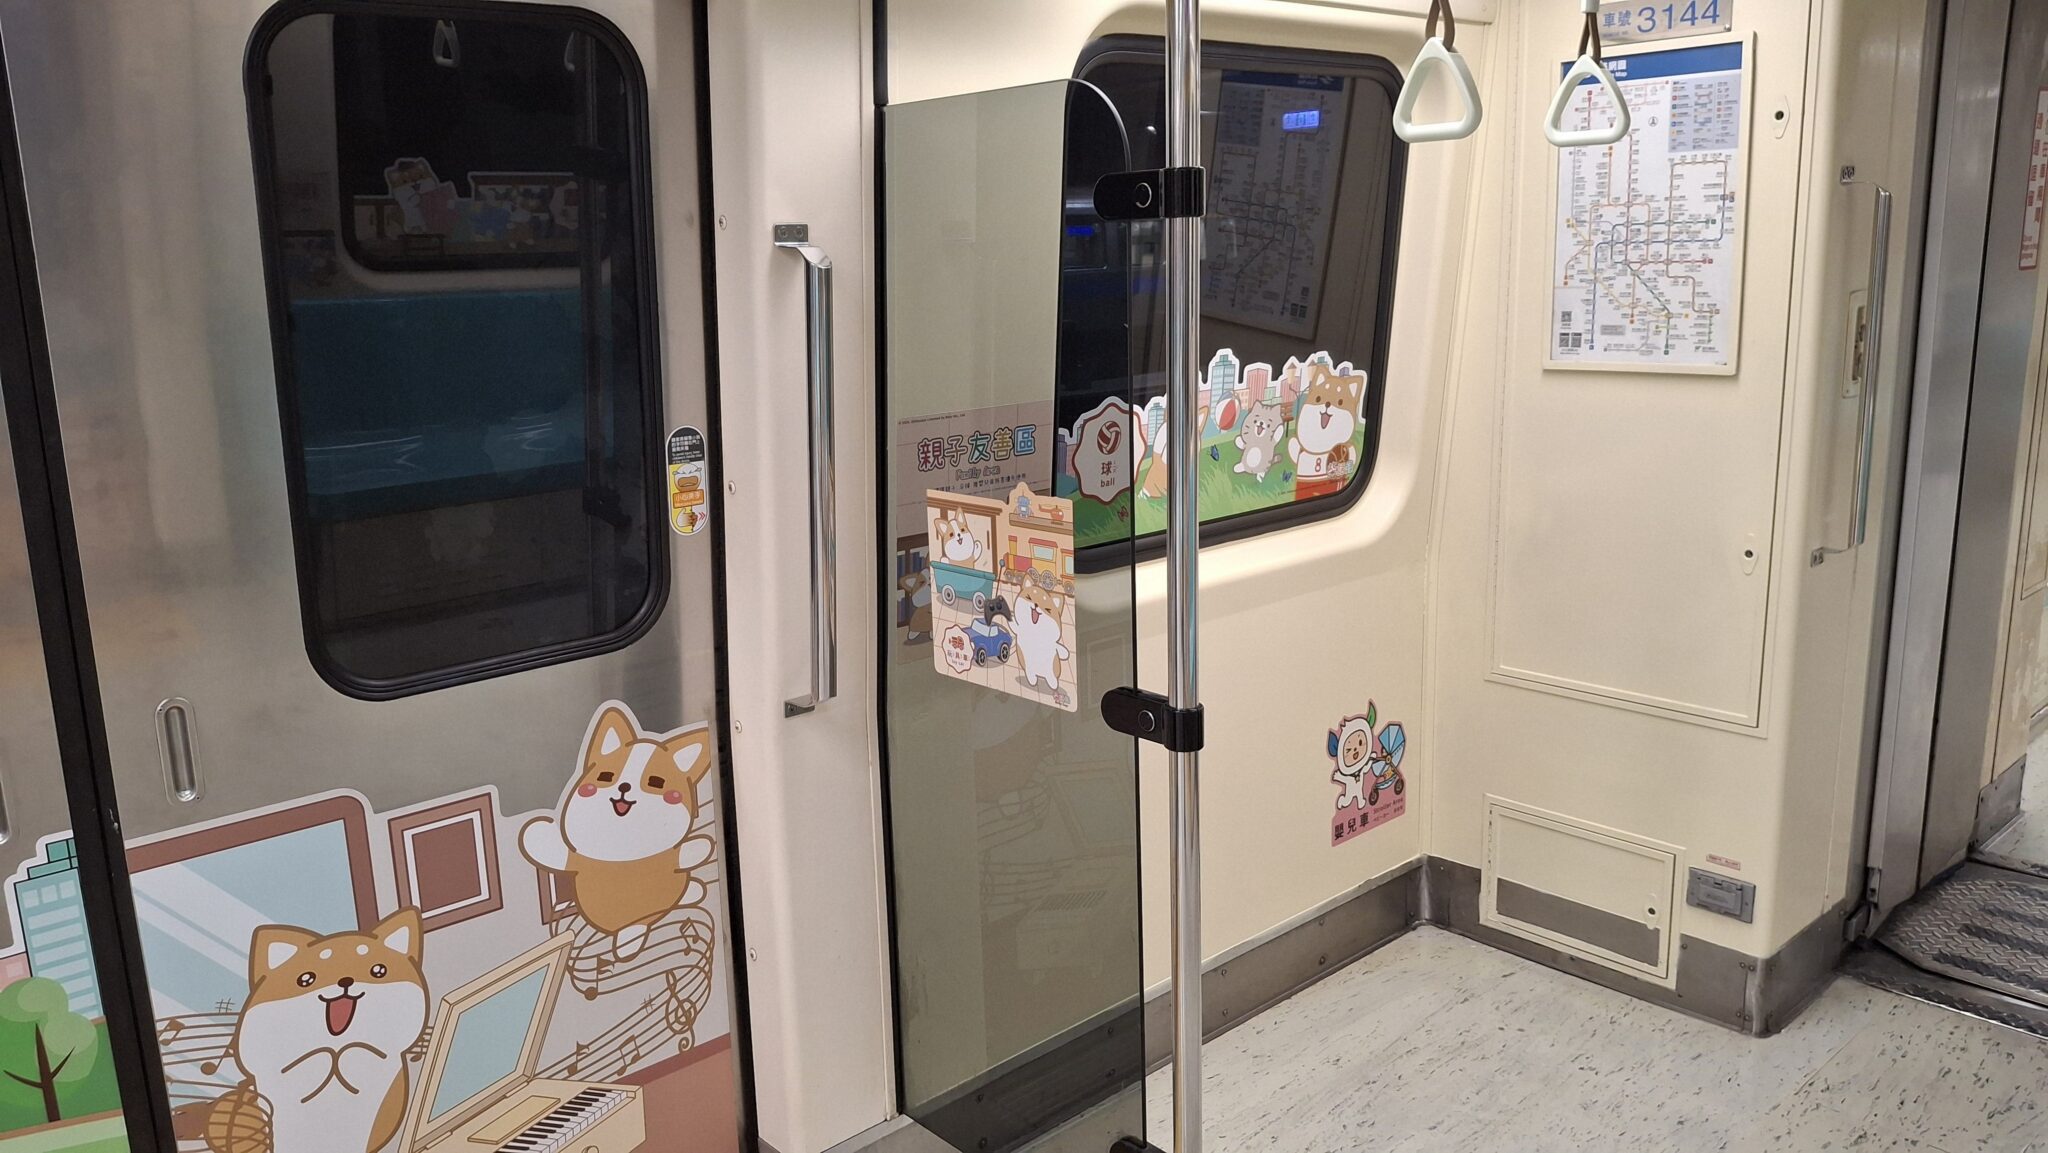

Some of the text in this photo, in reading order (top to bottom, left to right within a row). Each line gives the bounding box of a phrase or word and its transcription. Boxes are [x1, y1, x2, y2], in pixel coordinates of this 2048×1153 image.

[1603, 0, 1720, 33] 車號 3144
[918, 424, 1036, 473] 親子友善區
[1101, 461, 1112, 476] 球
[1314, 457, 1322, 472] 8
[1101, 477, 1115, 487] ball
[1334, 812, 1369, 840] 嬰兒車
